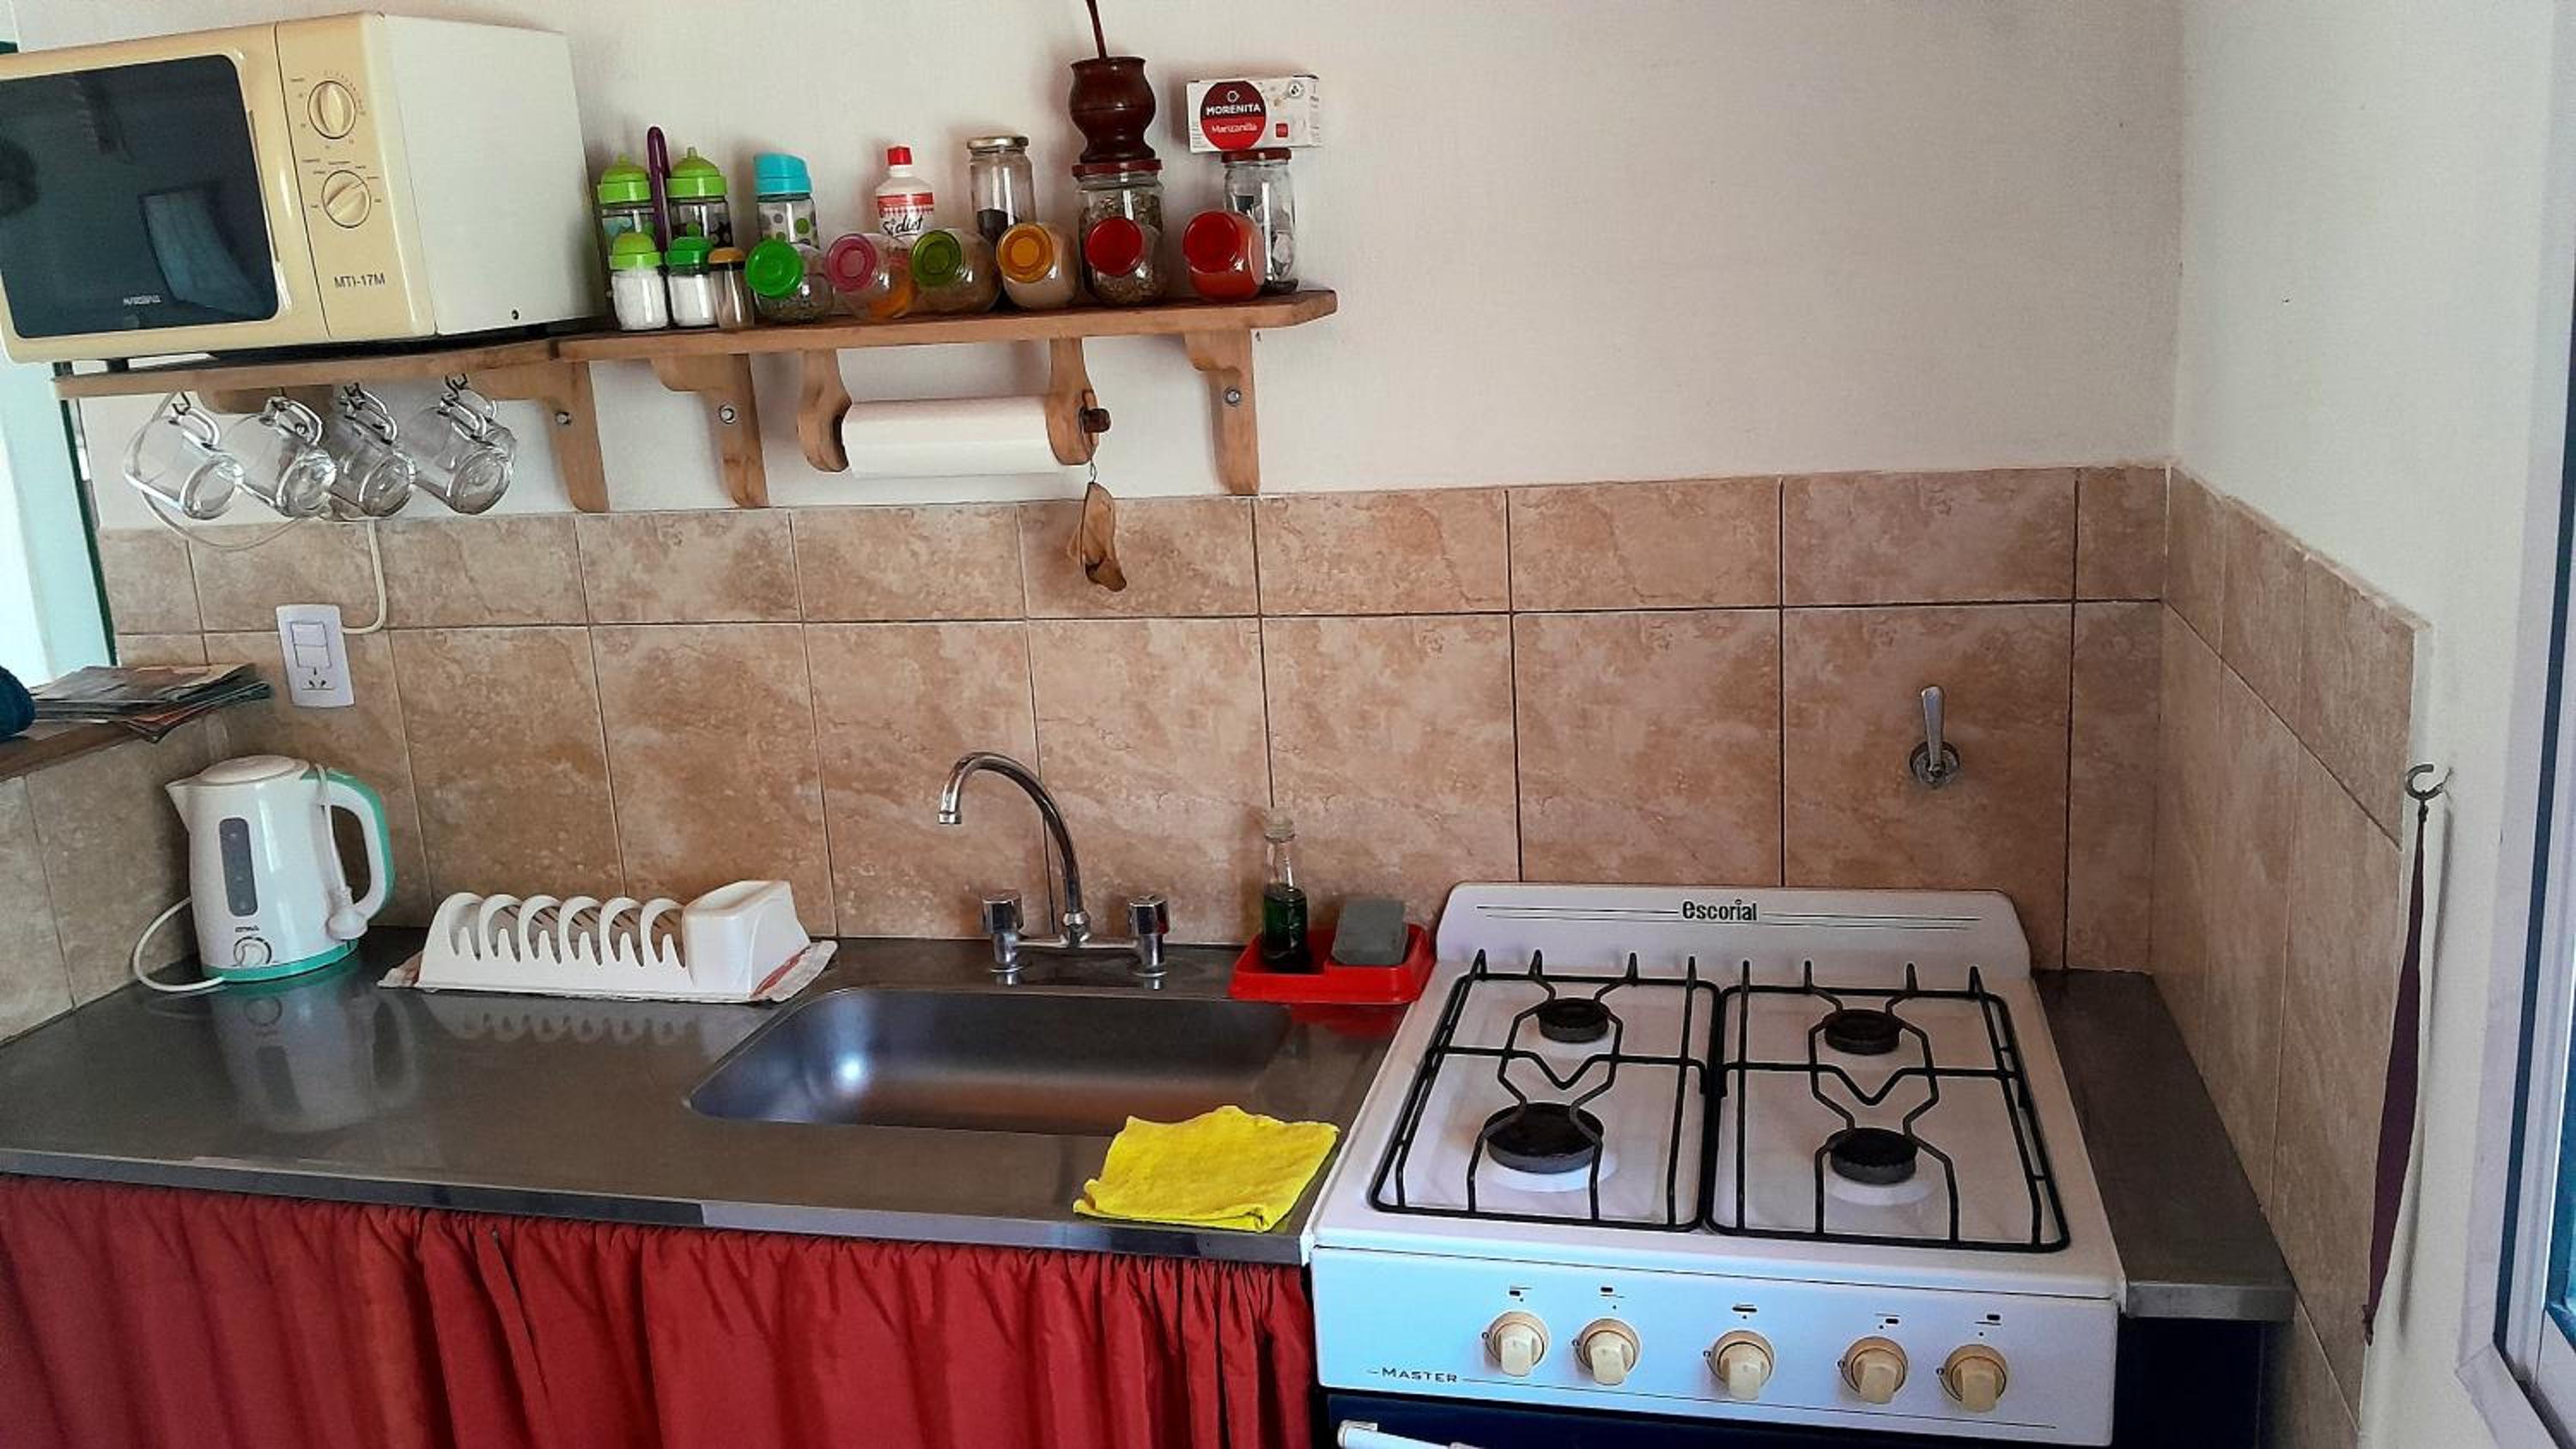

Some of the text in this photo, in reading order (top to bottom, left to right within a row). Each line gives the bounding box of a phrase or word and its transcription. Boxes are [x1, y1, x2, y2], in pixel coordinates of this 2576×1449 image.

[1206, 103, 1261, 116] MORENITA
[1212, 123, 1258, 133] Manzanilla
[333, 272, 386, 288] MTI-17M
[1682, 899, 1758, 921] escorial
[1382, 1367, 1457, 1383] MASTER
